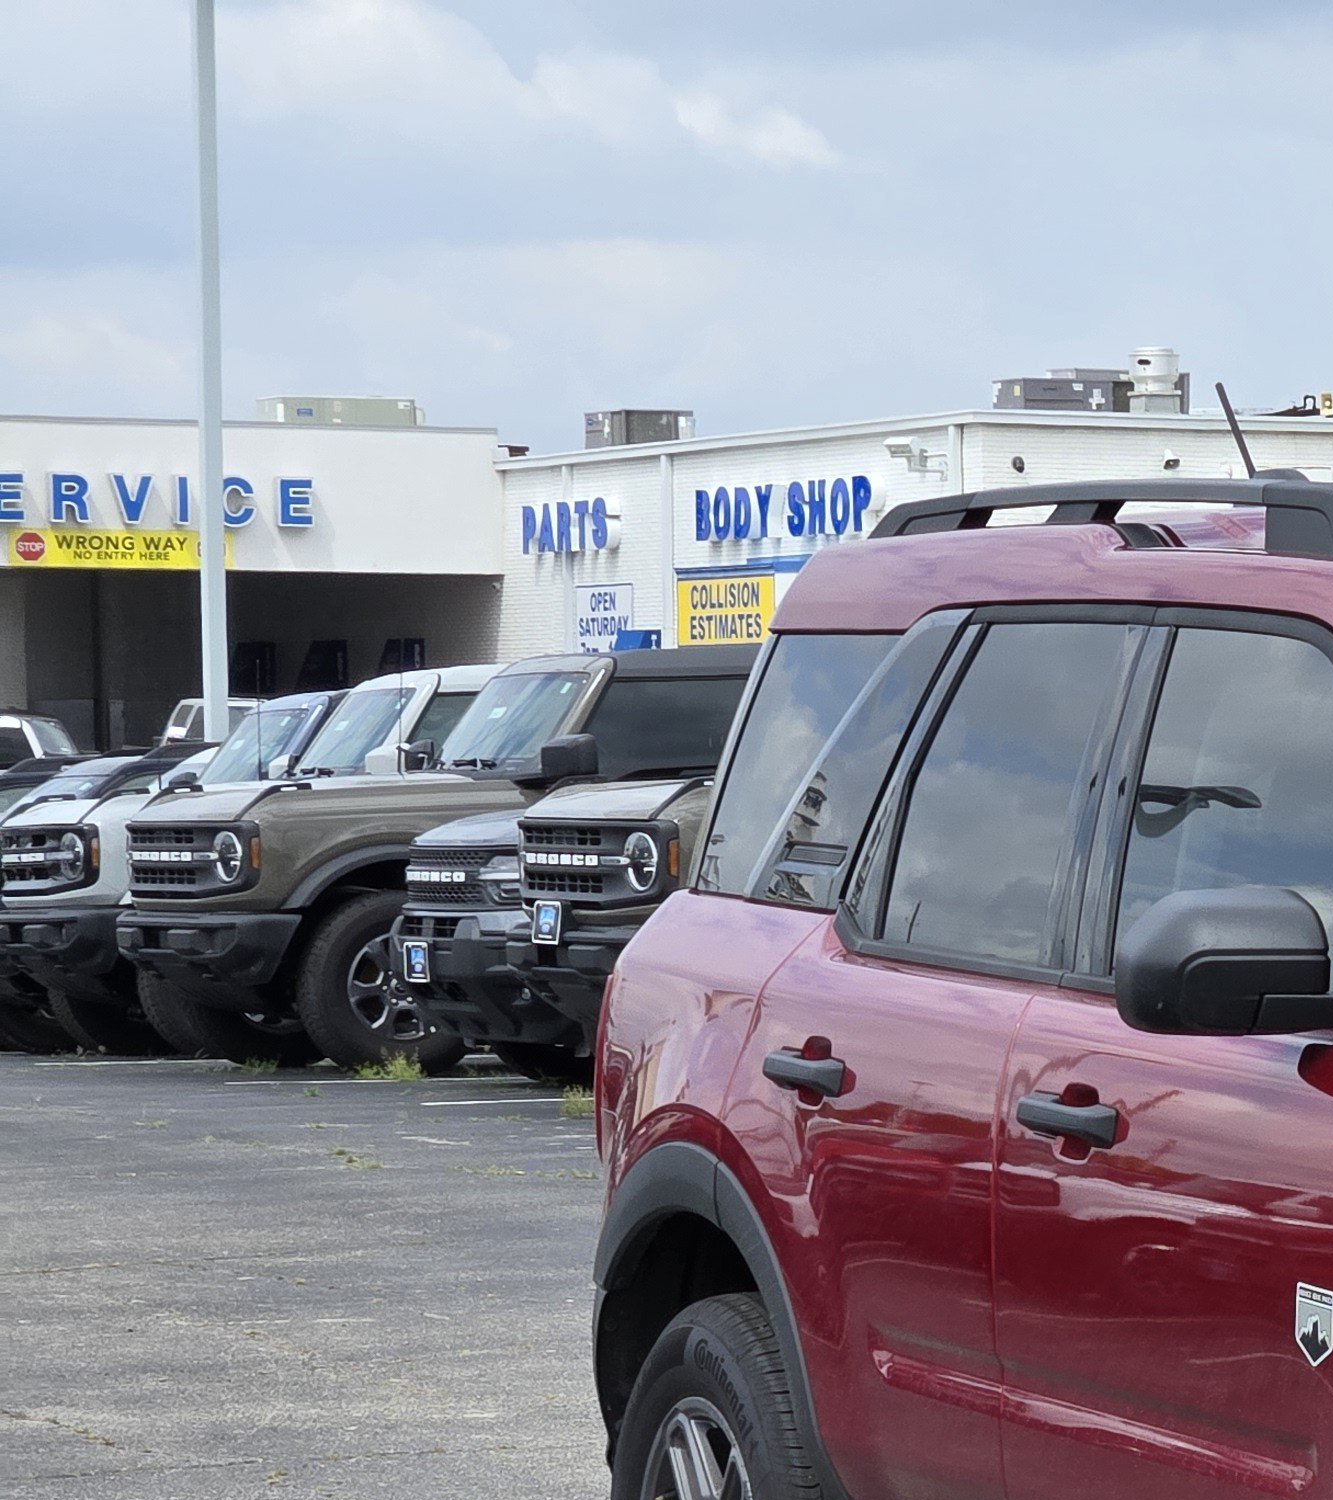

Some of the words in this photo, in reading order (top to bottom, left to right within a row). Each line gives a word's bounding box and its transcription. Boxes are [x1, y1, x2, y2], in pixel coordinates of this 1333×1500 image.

[695, 484, 774, 542] BODY
[786, 475, 873, 538] SHOP
[522, 496, 609, 555] PARTS
[17, 541, 45, 552] STOP
[54, 534, 135, 551] WRONG
[143, 536, 189, 551] WAY
[73, 550, 92, 560] NO
[97, 550, 136, 561] ENTRY
[139, 551, 171, 561] HERE
[590, 592, 616, 612] OPEN
[690, 581, 760, 610] COLLISION
[578, 615, 629, 637] SATURDAY
[690, 613, 762, 641] ESTIMATES
[693, 1338, 754, 1442] Continental
